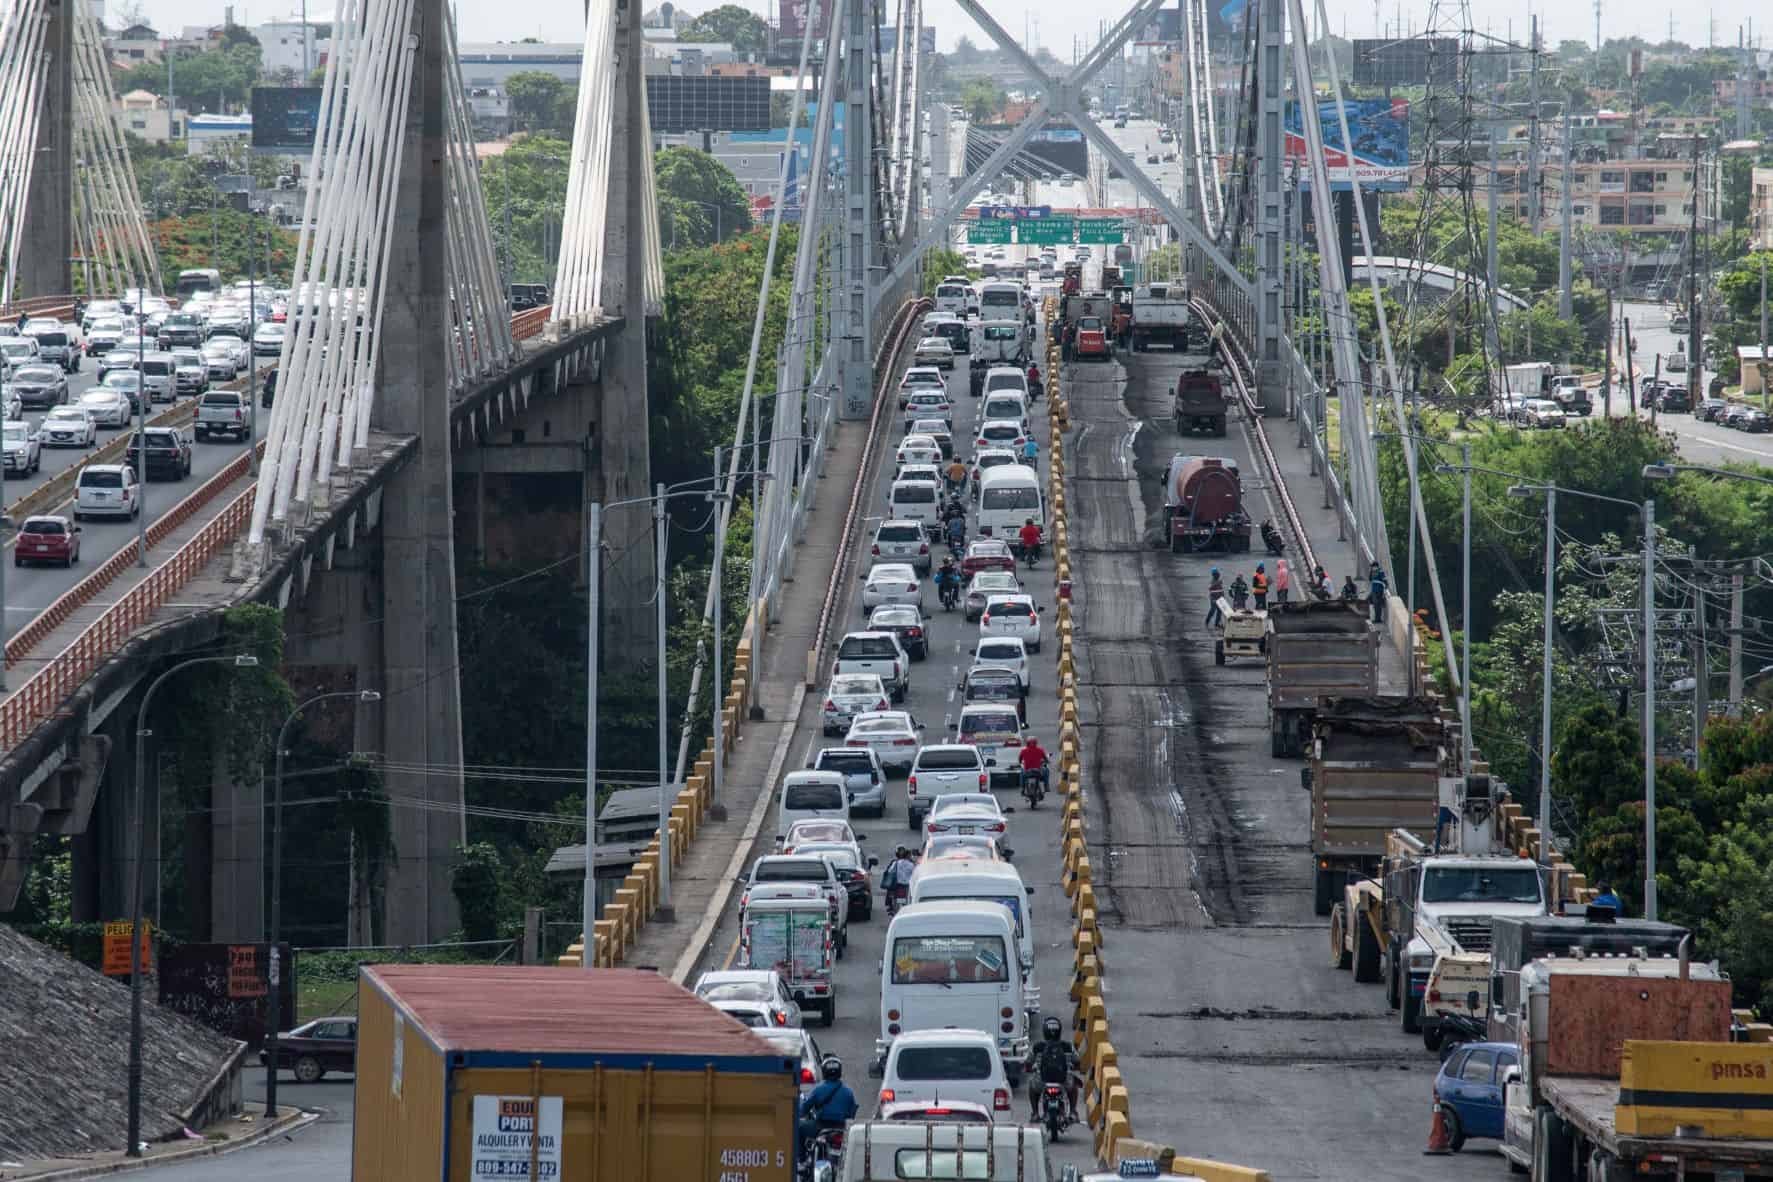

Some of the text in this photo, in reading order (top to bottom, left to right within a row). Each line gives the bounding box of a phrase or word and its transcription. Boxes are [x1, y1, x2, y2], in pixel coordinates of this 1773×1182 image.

[478, 1134, 555, 1149] ALQUILER Y VNTA
[720, 1149, 784, 1167] 458803 5
